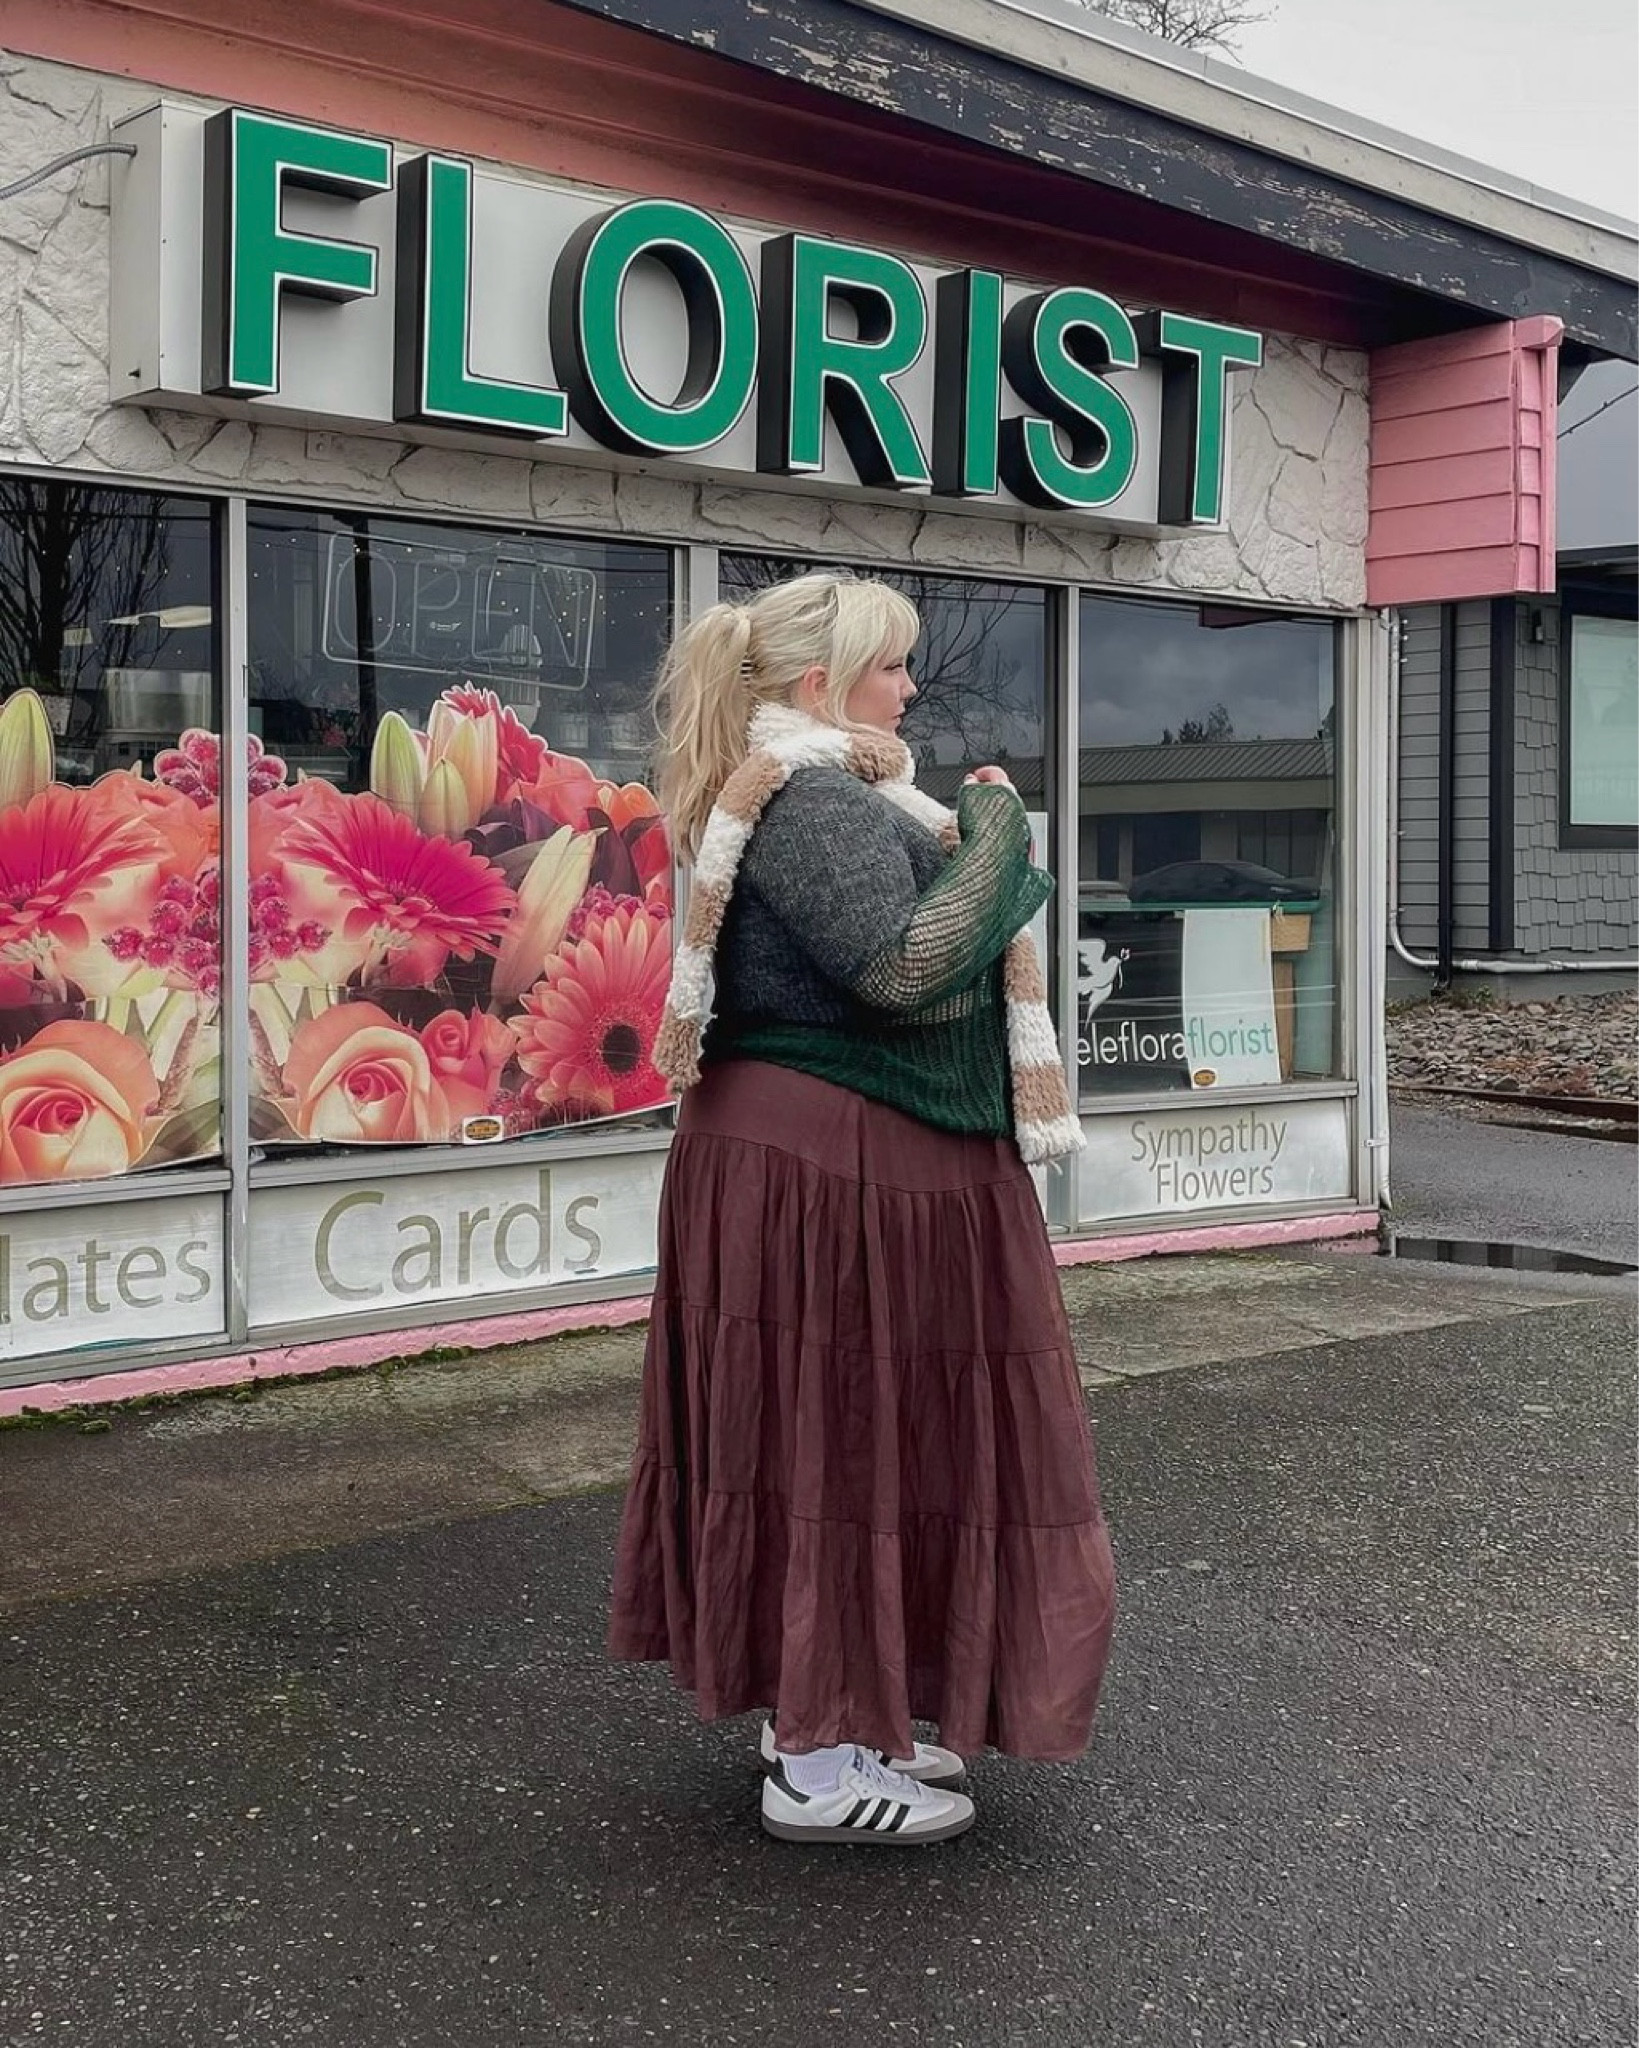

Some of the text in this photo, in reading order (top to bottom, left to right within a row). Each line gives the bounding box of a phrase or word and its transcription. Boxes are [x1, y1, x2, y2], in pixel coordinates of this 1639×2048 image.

[227, 107, 1264, 526] FLORIST
[335, 550, 582, 668] OPEN
[1187, 1016, 1274, 1058] florist
[1131, 1110, 1288, 1173] Sympathy
[1156, 1161, 1274, 1205] Flowers
[314, 1168, 601, 1301] Cards
